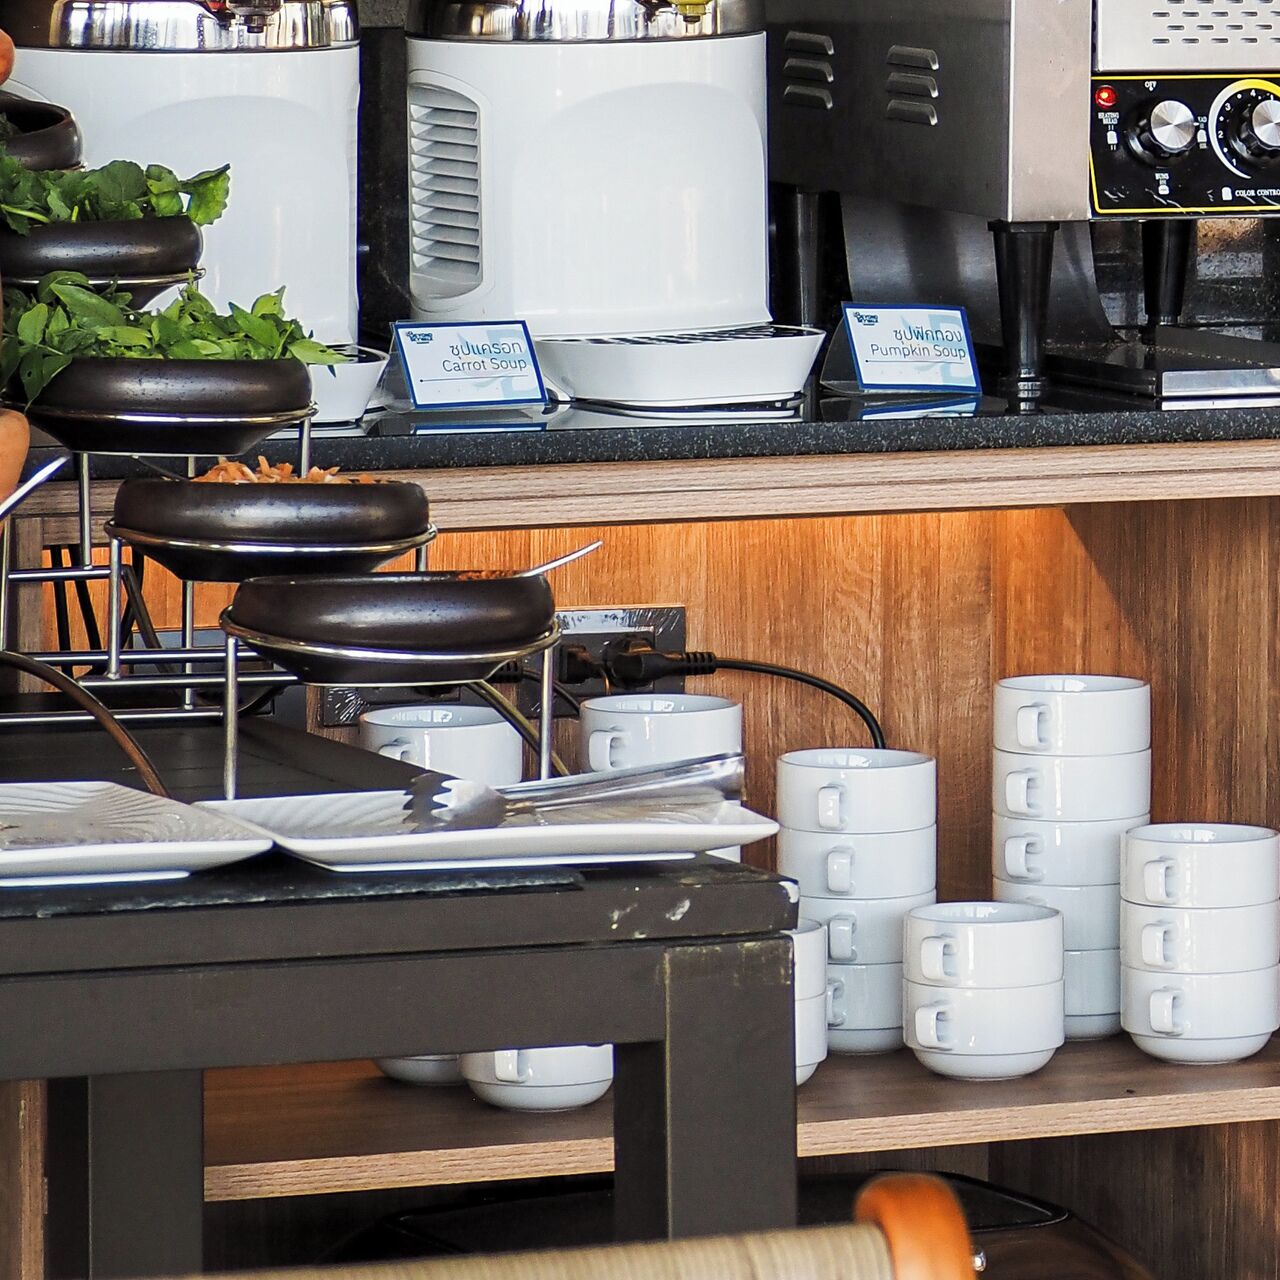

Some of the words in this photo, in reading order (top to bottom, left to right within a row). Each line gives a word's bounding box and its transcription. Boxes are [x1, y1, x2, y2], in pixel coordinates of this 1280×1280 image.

[1250, 89, 1257, 97] 4
[1225, 102, 1231, 112] 3
[1218, 130, 1224, 139] 2
[1232, 158, 1237, 167] 1
[1235, 189, 1256, 197] COLOR
[893, 326, 962, 345] ซุปฟักทอง
[871, 344, 931, 358] Pumpkin
[933, 344, 966, 360] Soup
[442, 359, 487, 372] Carrot
[491, 357, 527, 371] Soup
